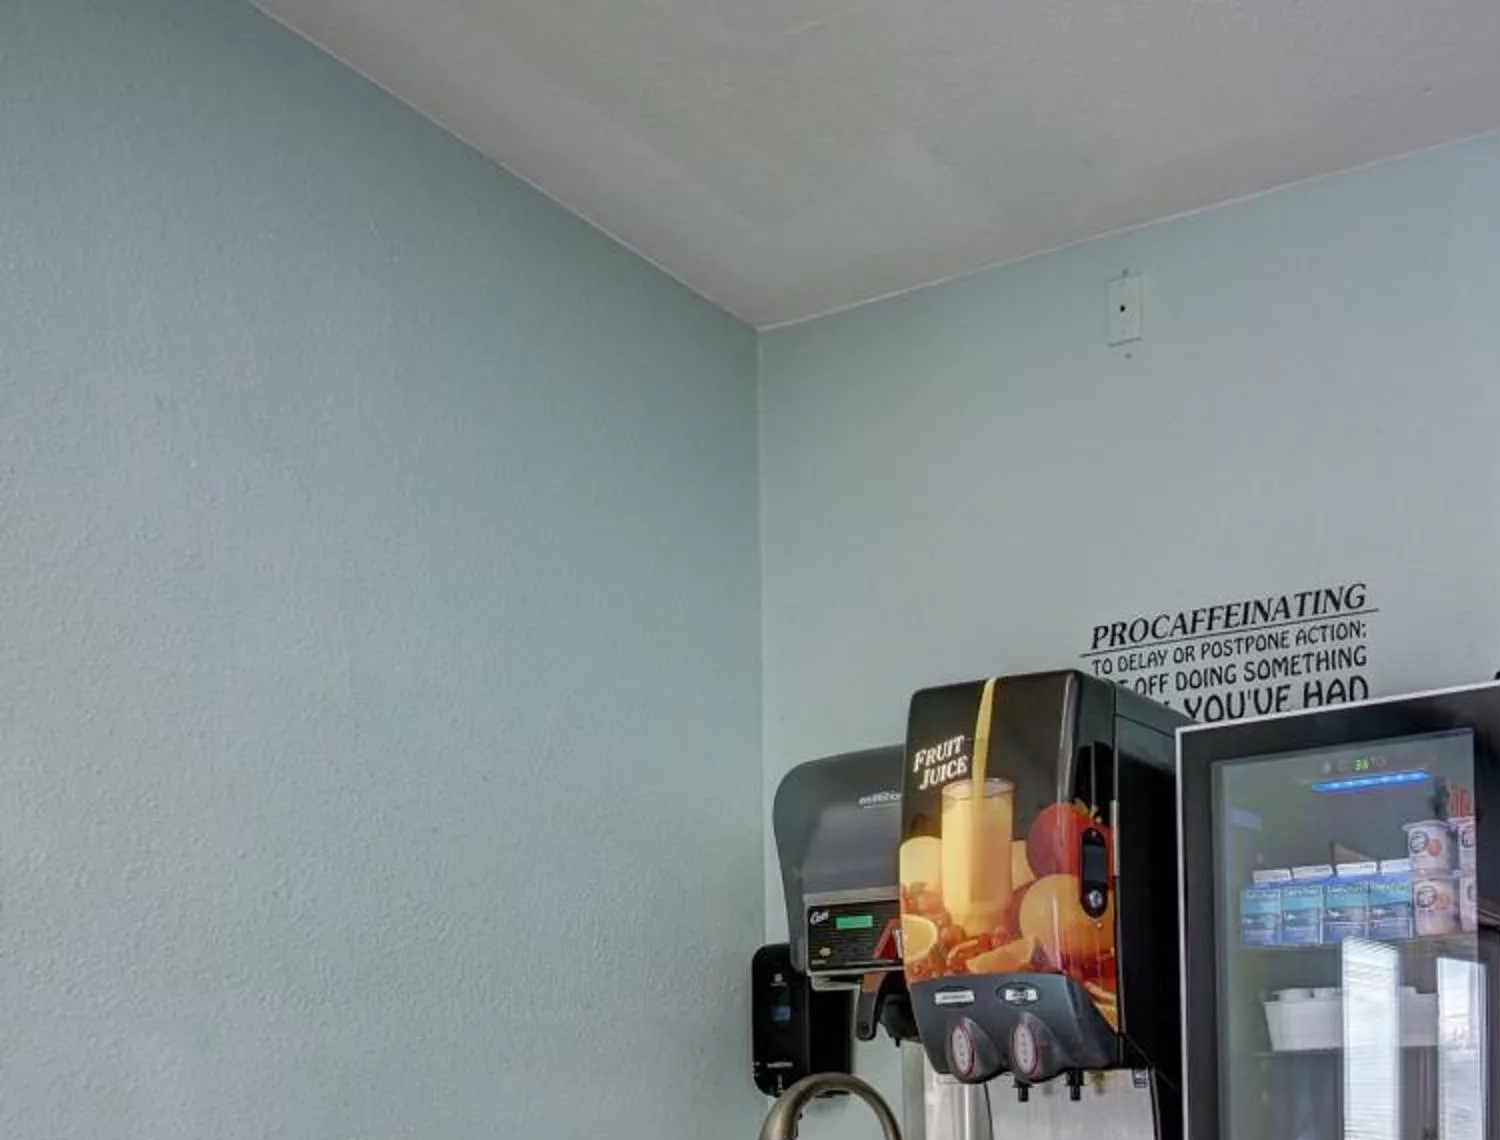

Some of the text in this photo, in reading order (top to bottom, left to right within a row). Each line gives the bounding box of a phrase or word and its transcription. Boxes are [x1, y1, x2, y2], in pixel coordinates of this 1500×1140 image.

[1090, 583, 1368, 650] PROCAFFEINATING
[1092, 620, 1368, 675] TO DELAY OR POSTPONE ACTION:
[1135, 646, 1368, 695] OFF DOING SOMETHING
[1183, 675, 1369, 723] YOU'VE HAD
[912, 734, 966, 773] FRUIT
[918, 753, 970, 791] JUICE
